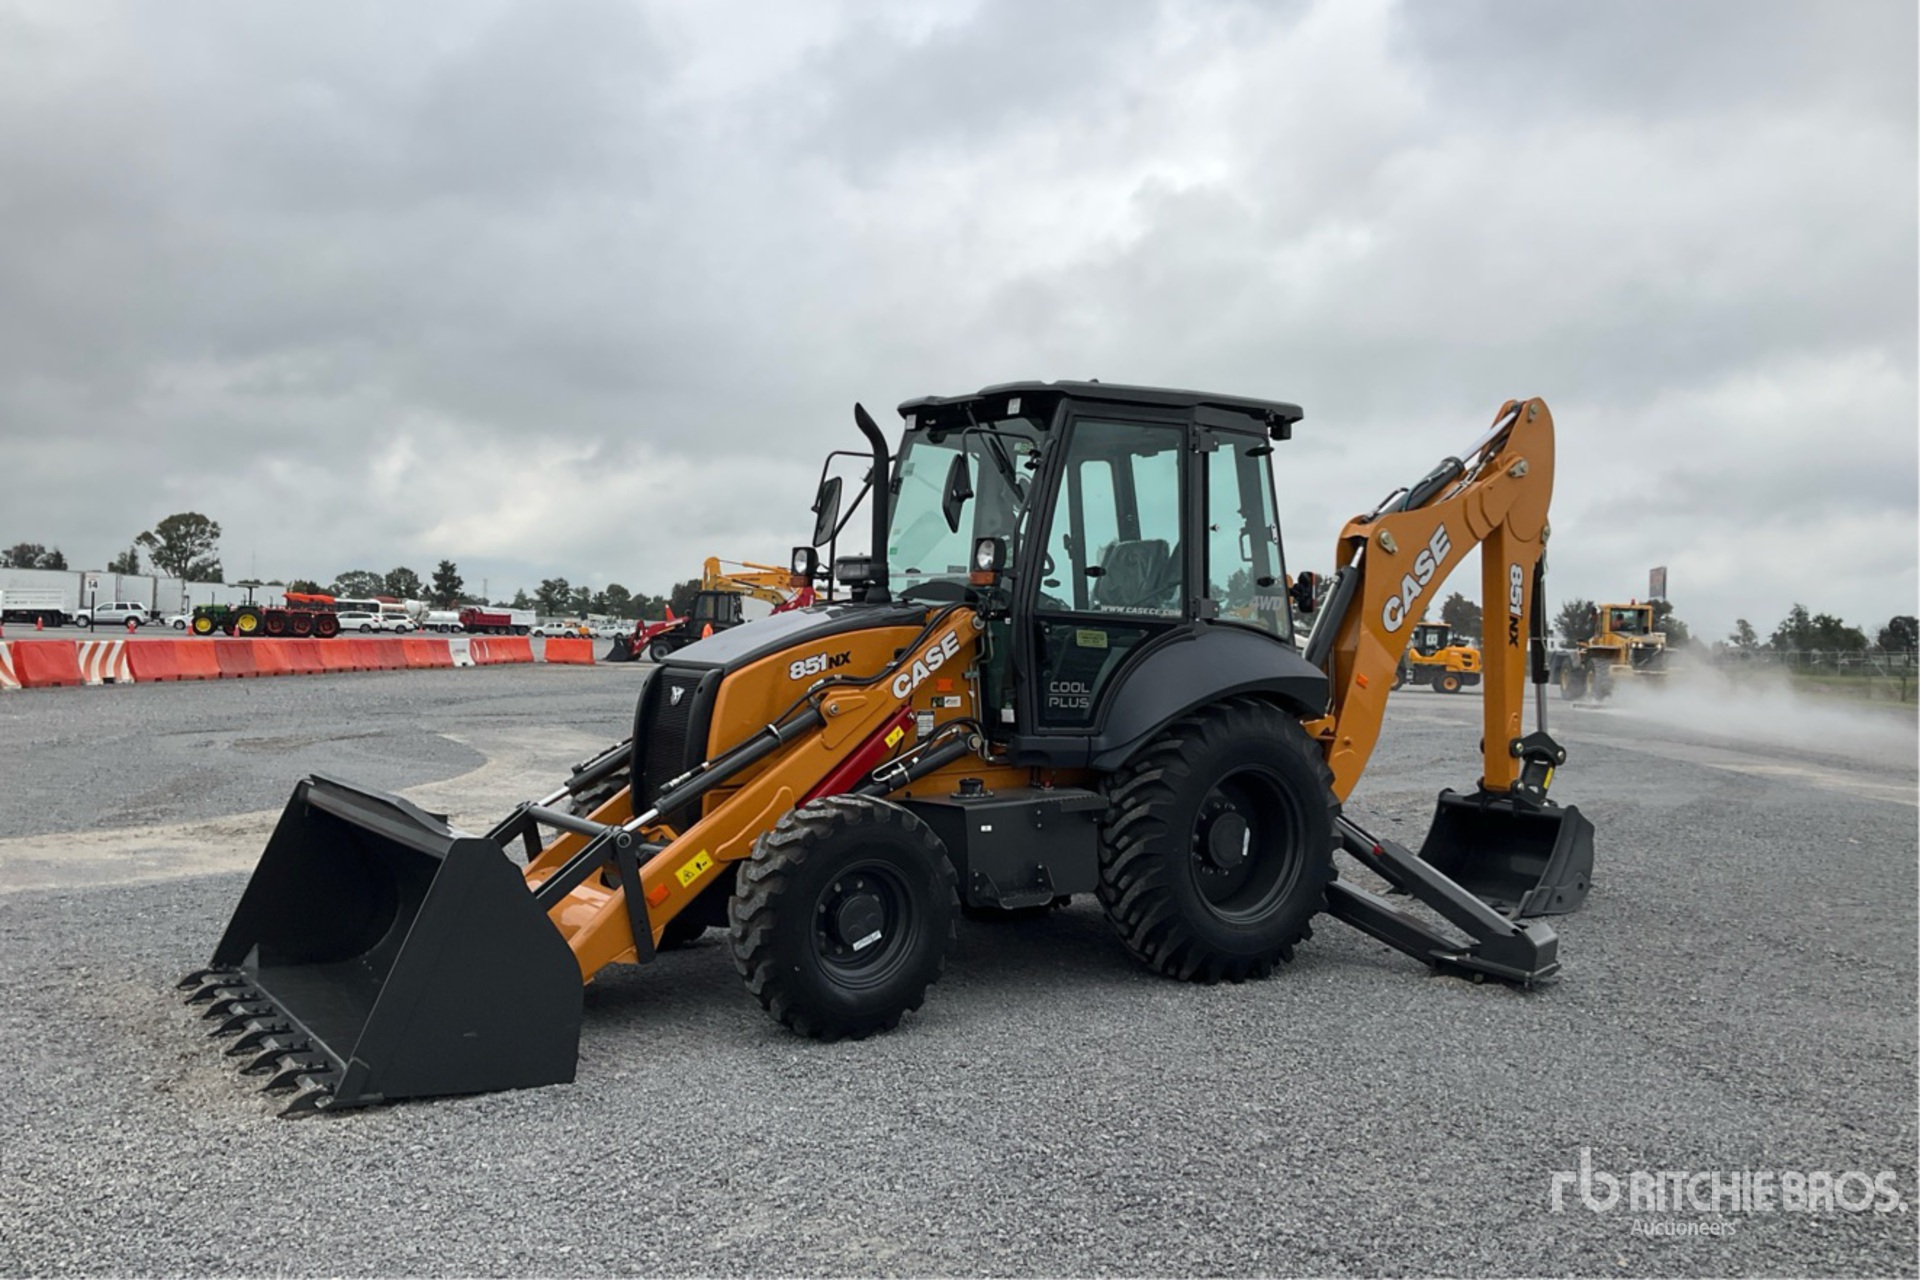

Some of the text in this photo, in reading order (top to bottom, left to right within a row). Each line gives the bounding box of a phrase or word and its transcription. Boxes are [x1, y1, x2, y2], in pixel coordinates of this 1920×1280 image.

[1382, 523, 1452, 633] CASE
[1250, 595, 1283, 611] 4WD
[892, 629, 961, 700] CASE
[1050, 681, 1090, 693] COOL
[1048, 697, 1090, 708] PLUS
